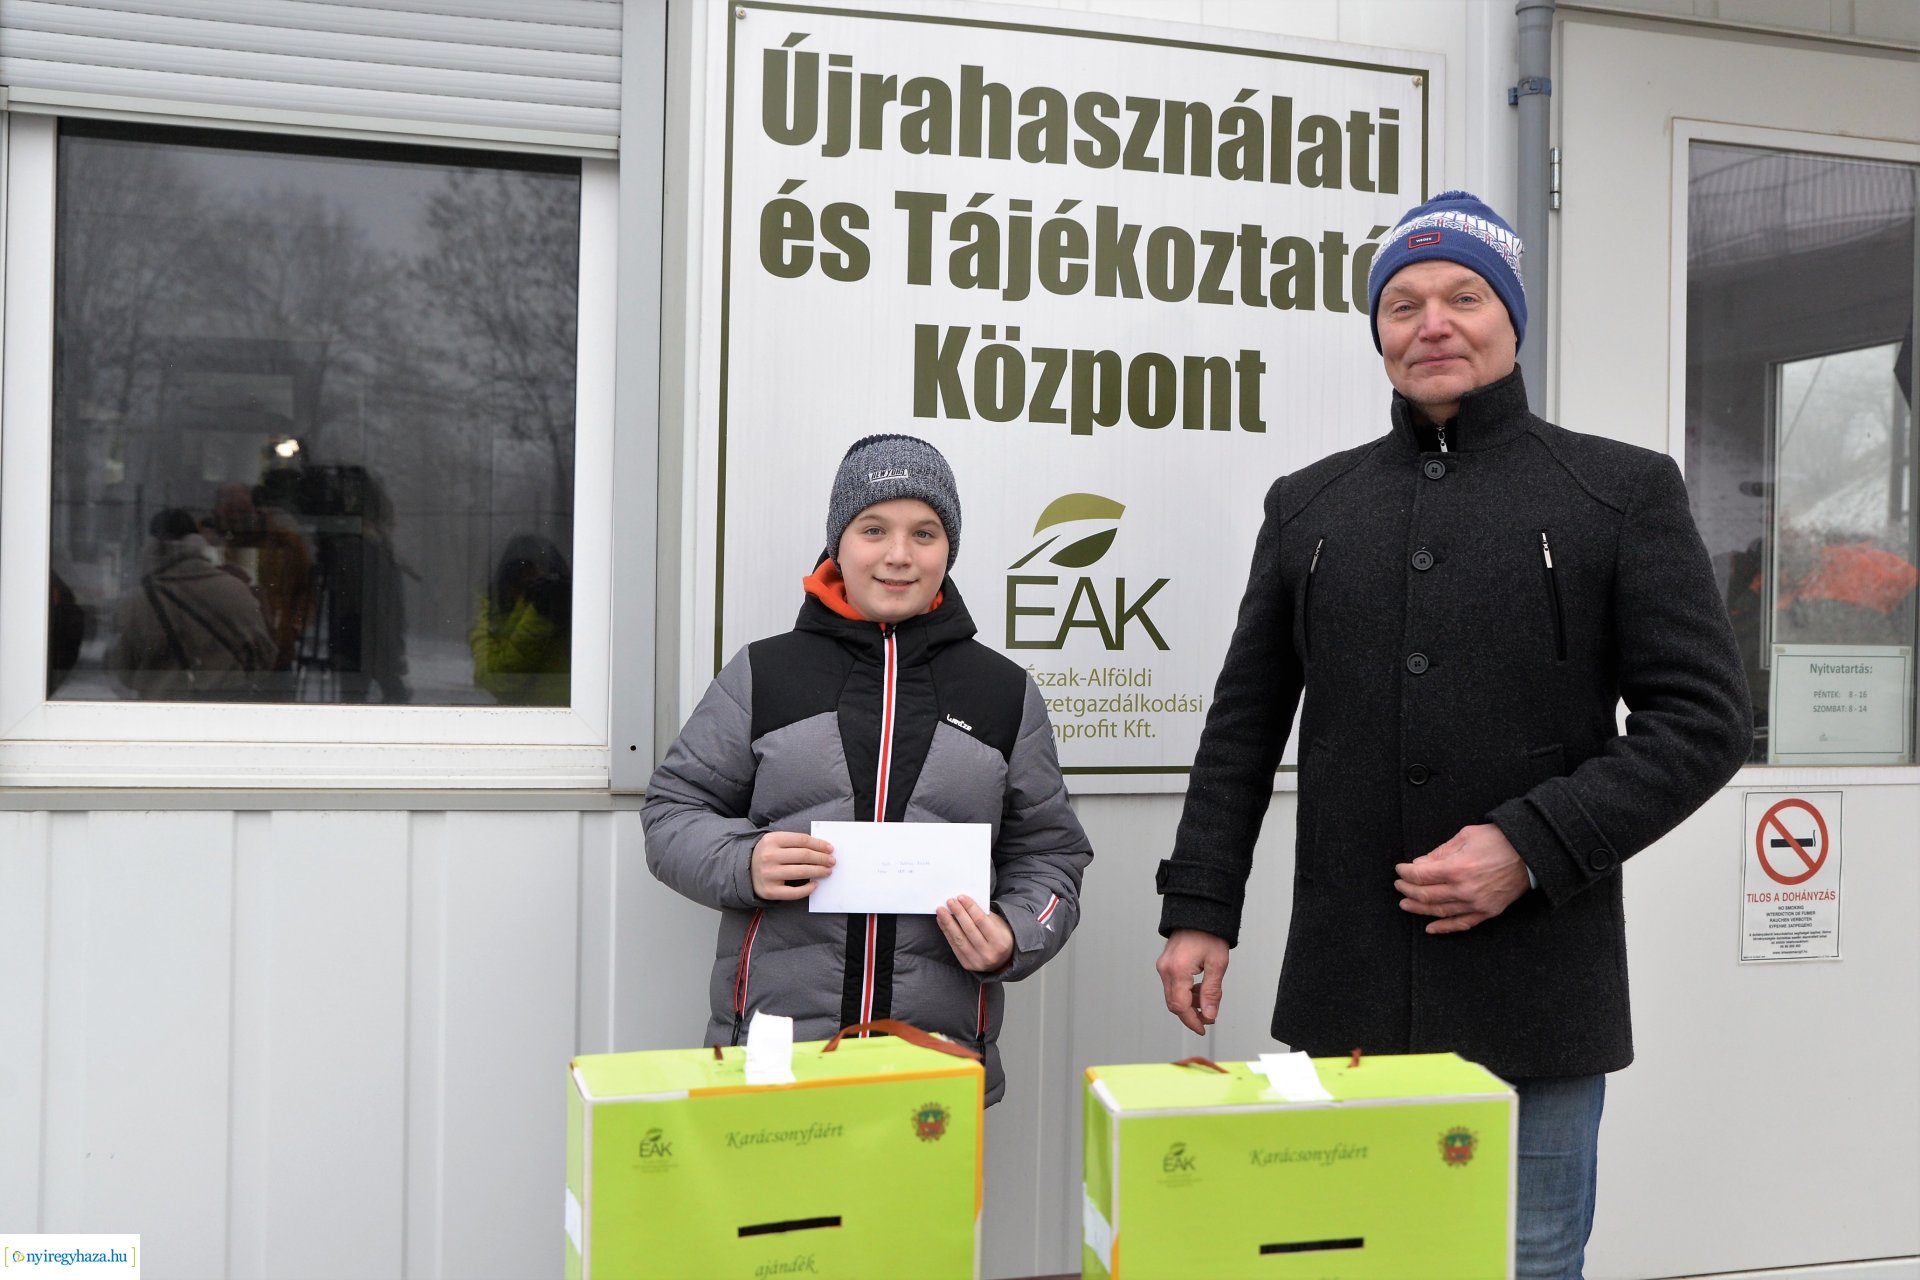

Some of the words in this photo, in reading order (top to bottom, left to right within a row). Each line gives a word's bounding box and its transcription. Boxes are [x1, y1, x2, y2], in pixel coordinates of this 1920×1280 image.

[762, 33, 1399, 196] Újrahasználati
[759, 179, 871, 283] és
[912, 323, 1267, 436] Központ
[1810, 663, 1873, 676] Nyitvatartás:
[1045, 694, 1203, 717] zetgazdálkodási
[1813, 690, 1840, 698] PÉNTEK:
[1812, 705, 1847, 713] SZOMBAT:
[1052, 719, 1118, 743] nprofit
[1124, 719, 1156, 738] Kft.
[1747, 892, 1772, 903] TILOS
[1774, 892, 1780, 902] A
[1782, 888, 1836, 902] DOHÁNYZÁS
[726, 1123, 843, 1149] Karácsonyfáért
[1249, 1143, 1368, 1167] Karácsonyfáért
[754, 1253, 819, 1280] ajándék
